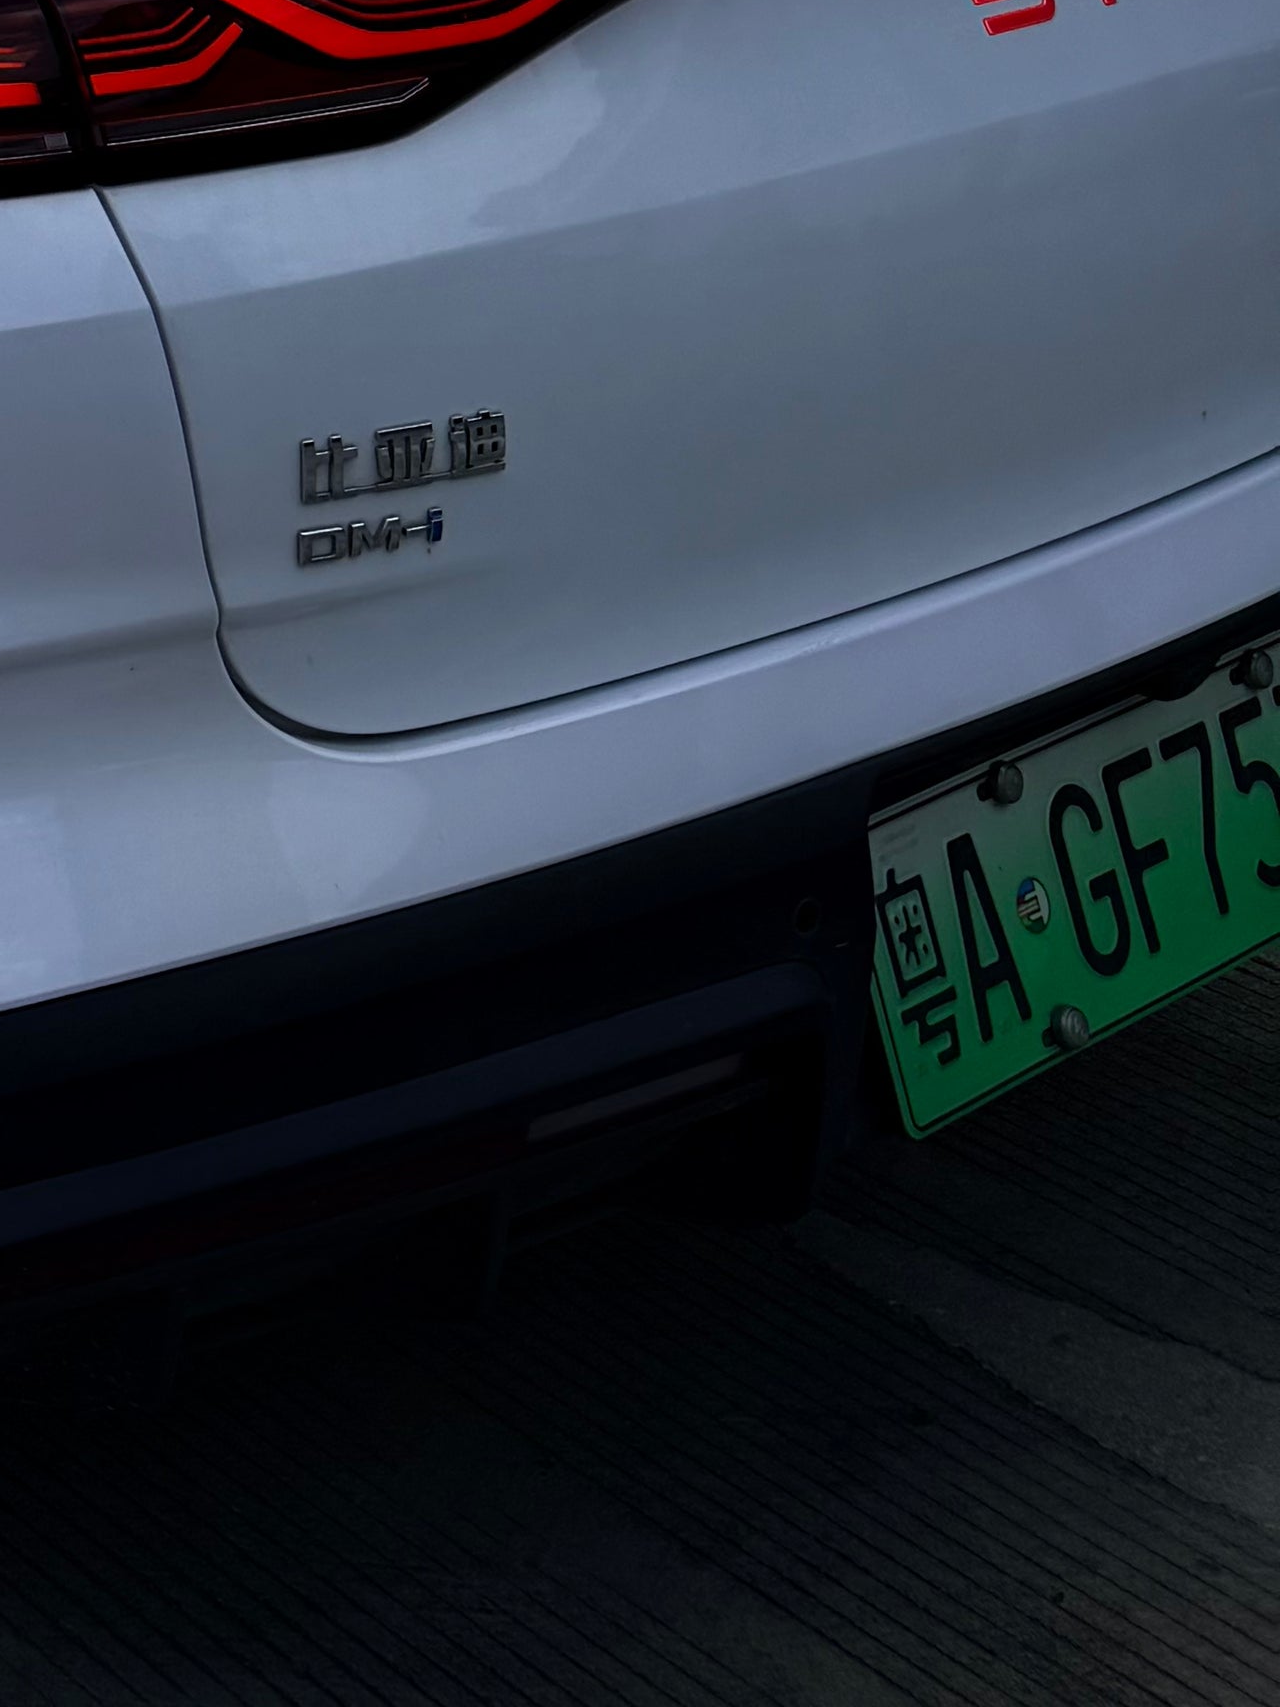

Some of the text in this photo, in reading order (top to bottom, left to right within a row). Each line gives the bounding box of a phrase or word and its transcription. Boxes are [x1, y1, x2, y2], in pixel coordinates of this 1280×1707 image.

[299, 407, 507, 505] 比亚迪
[876, 684, 1280, 1067] 粤AGF75
